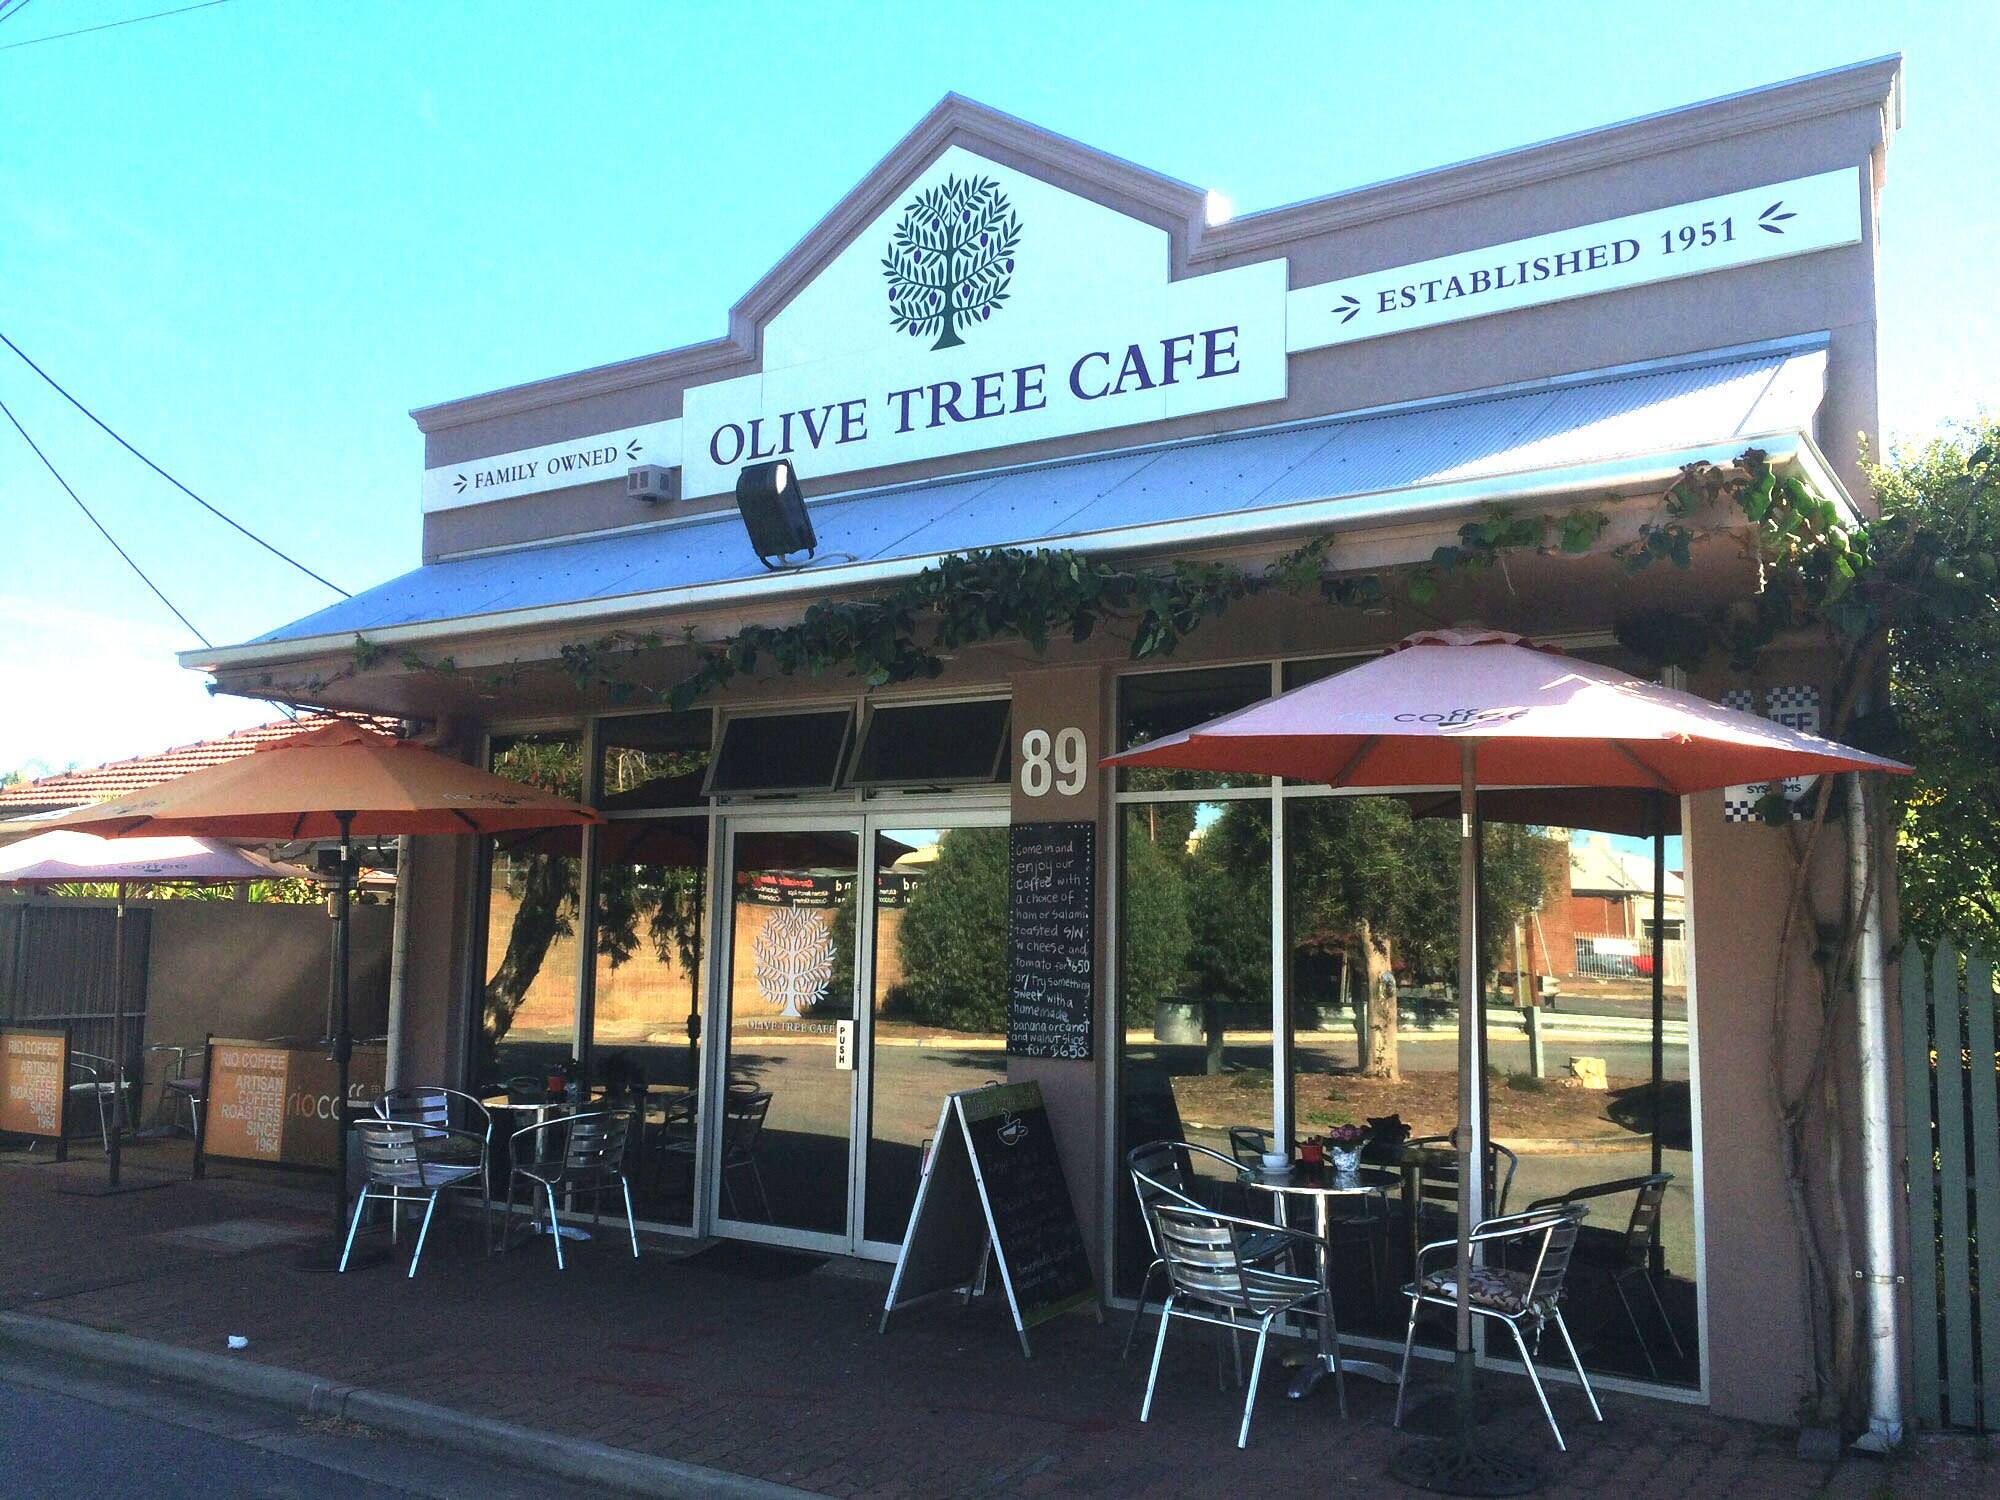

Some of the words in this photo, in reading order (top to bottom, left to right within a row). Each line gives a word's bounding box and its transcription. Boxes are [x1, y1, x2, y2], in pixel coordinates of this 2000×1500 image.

[1376, 238, 1640, 315] ESTABLISHED
[1660, 217, 1735, 255] 1951
[709, 398, 868, 467] OLIVE
[887, 364, 1047, 434] TREE
[1068, 326, 1240, 401] CAFE
[475, 462, 538, 488] FAMILY
[547, 446, 618, 474] OWNED
[1021, 727, 1087, 797] 89
[1747, 784, 1801, 794] SYSMS
[1055, 840, 1073, 853] and
[1016, 860, 1052, 880] enjoy
[1056, 859, 1074, 869] our
[1057, 874, 1080, 886] with
[1016, 894, 1023, 904] a
[1026, 893, 1058, 904] choice
[1061, 890, 1075, 905] of
[1016, 907, 1037, 920] ham
[1039, 911, 1050, 919] or
[1026, 941, 1065, 954] cheese
[1068, 943, 1088, 957] and
[1047, 992, 1066, 1007] with
[1067, 999, 1074, 1009] a
[1014, 1001, 1069, 1022] homemade
[747, 1020, 777, 1030] OLIVE
[781, 1022, 807, 1032] TREE
[1013, 1020, 1046, 1032] banana
[1048, 1023, 1060, 1033] or
[1011, 1032, 1028, 1042] and
[8, 1040, 23, 1054] RIO
[24, 1041, 59, 1056] COFFEE
[1025, 1043, 1046, 1055] for
[20, 1060, 58, 1075] ARTISAN
[221, 1052, 239, 1067] RIO
[241, 1053, 285, 1070] COFFEE
[23, 1073, 57, 1089] COFFEE
[235, 1075, 284, 1092] ARTISAN
[10, 1086, 57, 1102] ROASTERS
[238, 1090, 283, 1108] COFFEE
[30, 1101, 56, 1116] SINCE
[221, 1104, 281, 1123] ROASTERS
[246, 1121, 280, 1138] SINCE
[255, 1137, 278, 1153] 1964
